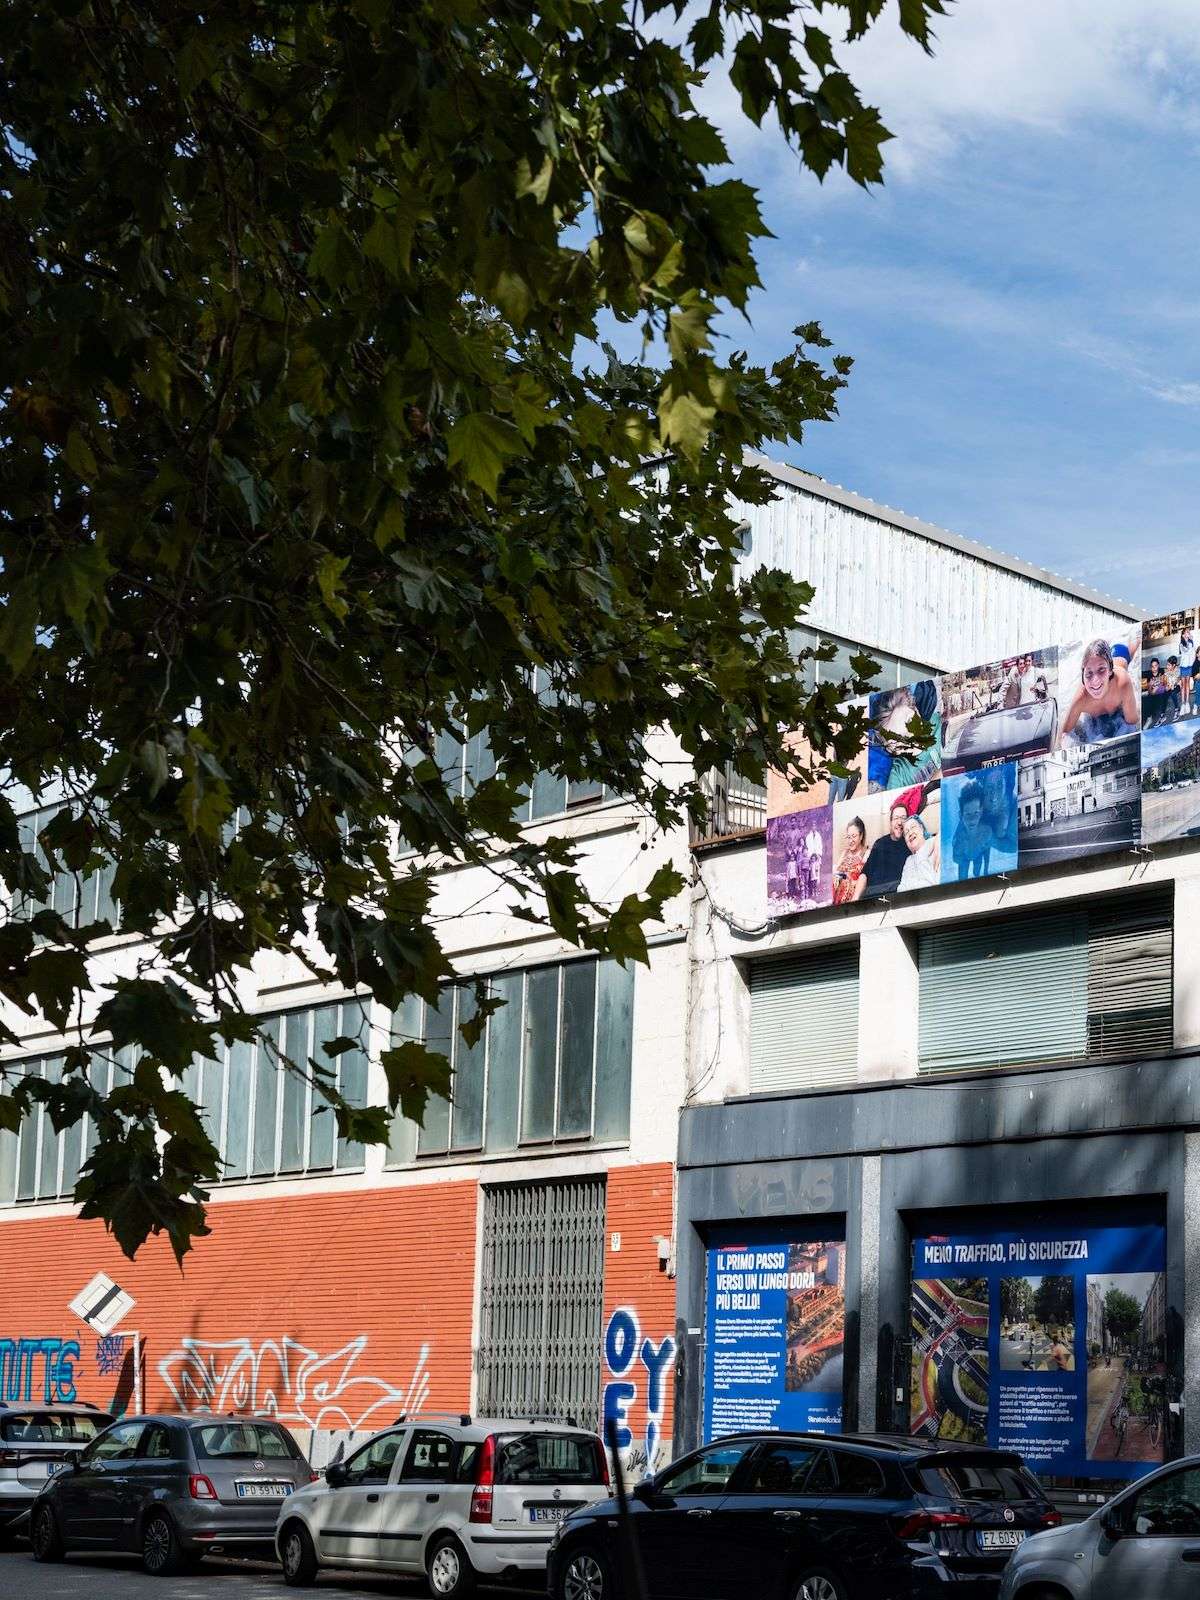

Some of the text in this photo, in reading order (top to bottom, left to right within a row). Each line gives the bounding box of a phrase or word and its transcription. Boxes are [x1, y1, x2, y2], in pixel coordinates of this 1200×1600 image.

[924, 1239, 1088, 1263] MENO TRAFFICO, PIÙ SICUREZZA
[717, 1253, 785, 1270] IL PRIMO PASSO
[716, 1272, 815, 1290] VERSO UN LUNGO DORA
[716, 1290, 761, 1311] PIÙ BELLO!
